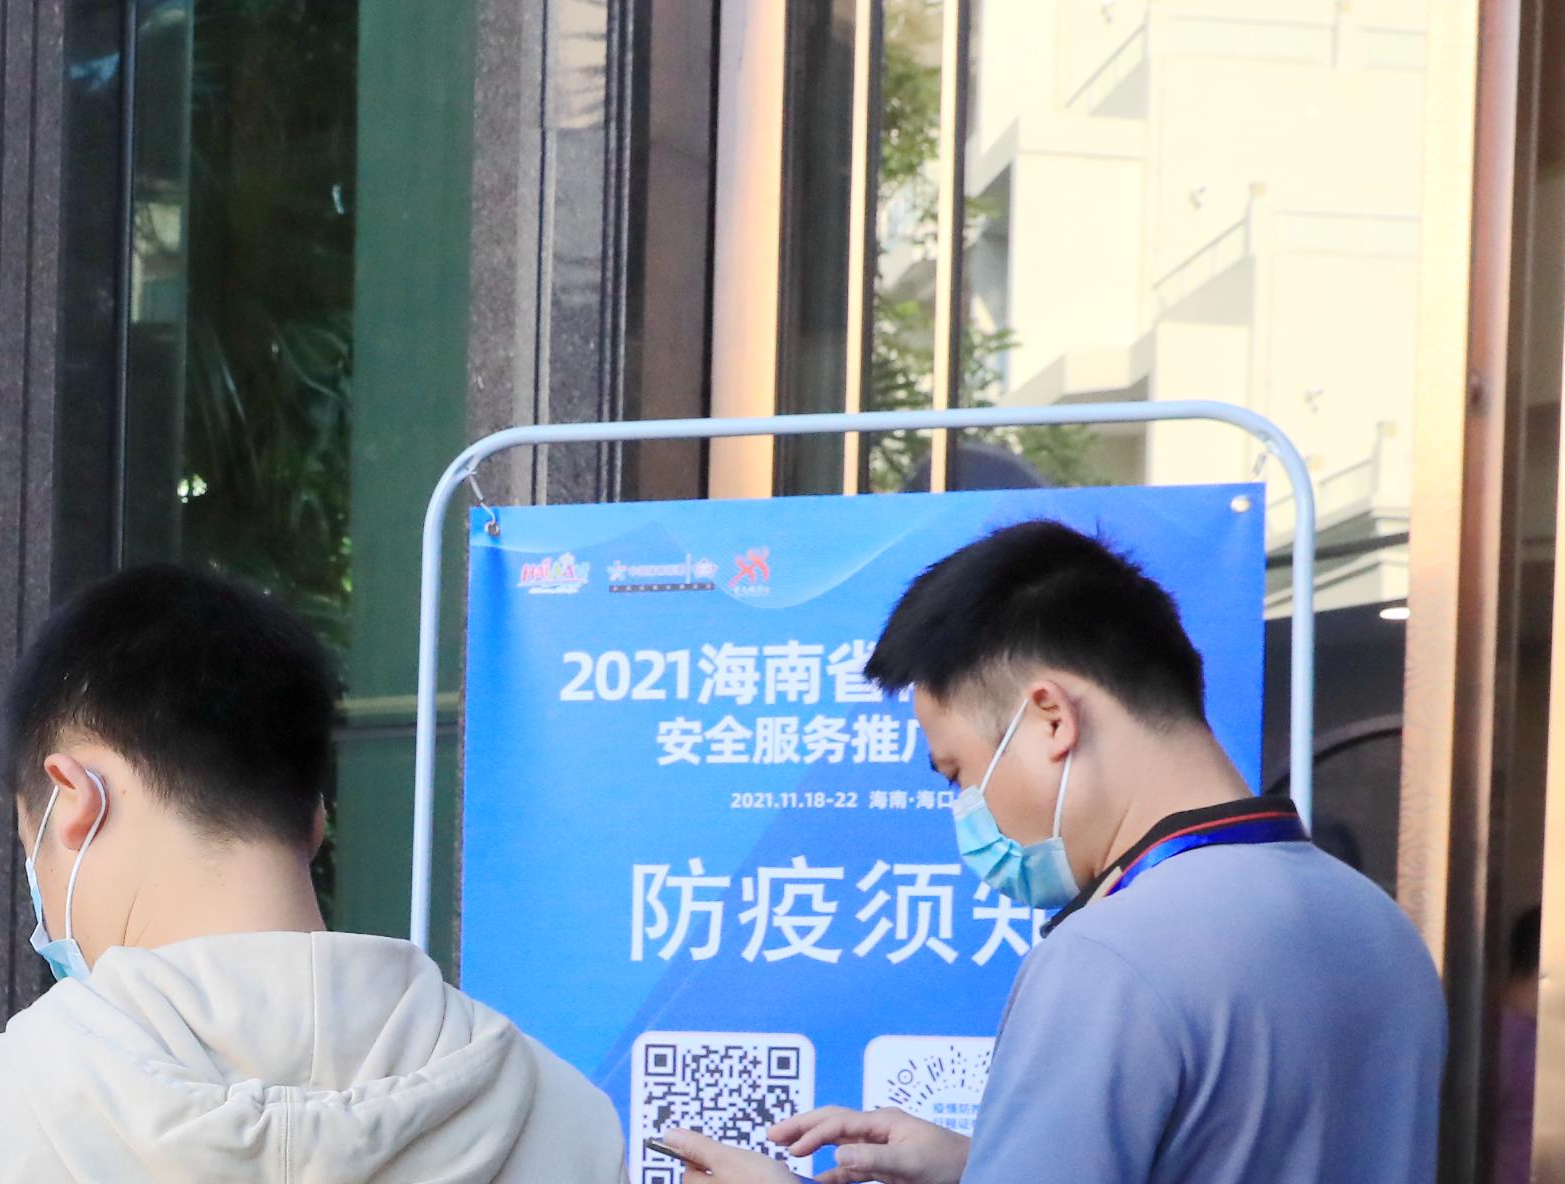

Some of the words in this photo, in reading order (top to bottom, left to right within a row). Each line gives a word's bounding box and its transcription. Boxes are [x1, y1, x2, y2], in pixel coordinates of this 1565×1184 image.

[559, 640, 914, 705] 2021海南省
[730, 792, 858, 809] 2021.11.18-22
[869, 791, 954, 810] 海南·海口
